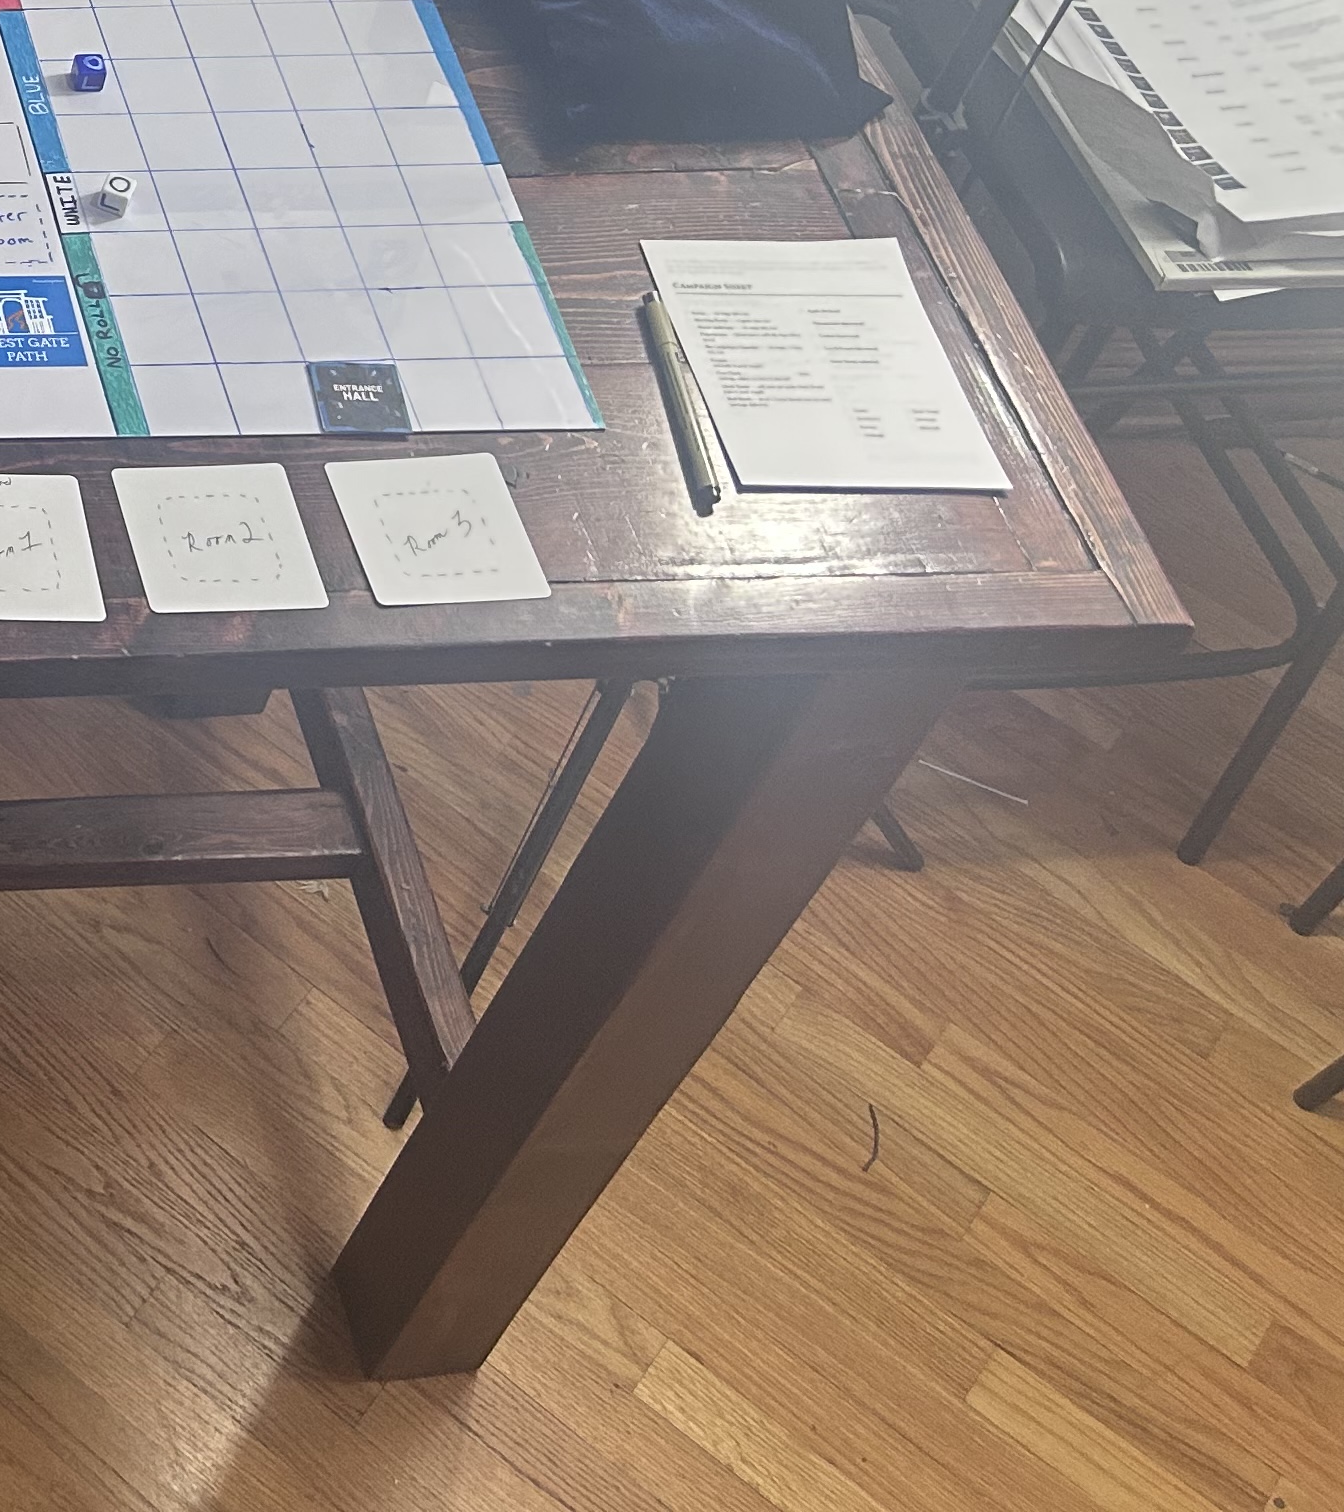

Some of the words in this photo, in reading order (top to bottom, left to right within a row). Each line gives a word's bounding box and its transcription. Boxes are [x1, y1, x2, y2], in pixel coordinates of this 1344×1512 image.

[23, 75, 50, 116] BLUE
[63, 175, 80, 226] WHITE
[87, 300, 113, 340] ROLL
[28, 337, 70, 348] GATE
[6, 350, 48, 362] PATH
[105, 346, 123, 369] NO
[333, 384, 383, 393] ENTRANCE
[342, 391, 379, 402] HALL
[17, 530, 43, 552] 1
[180, 530, 237, 553] Room
[239, 521, 264, 544] 2
[403, 527, 448, 557] Room
[451, 510, 473, 538] 3
